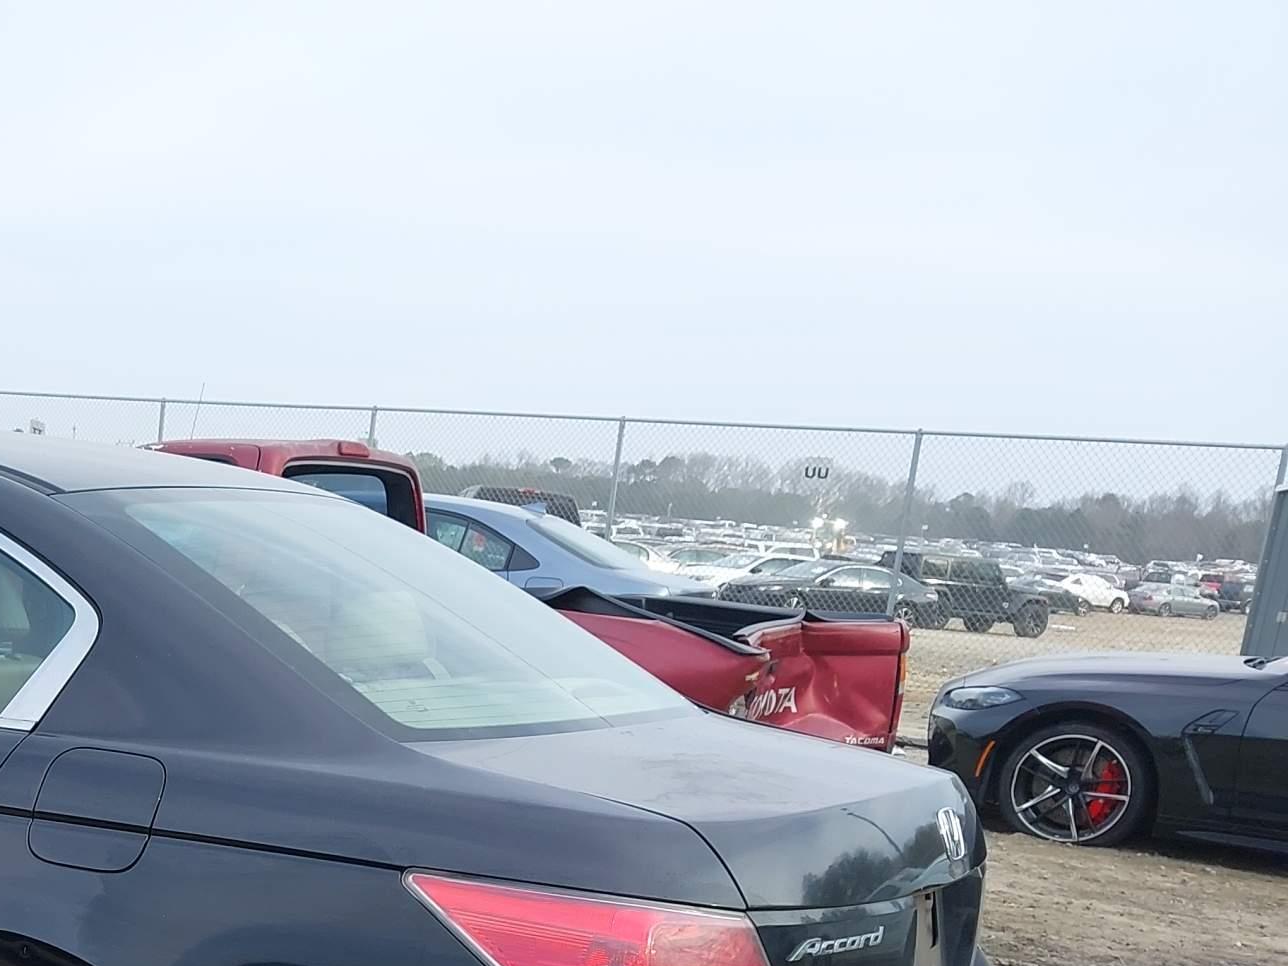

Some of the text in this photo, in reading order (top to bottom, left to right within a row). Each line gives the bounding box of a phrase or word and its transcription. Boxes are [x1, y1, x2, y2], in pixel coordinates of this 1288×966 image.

[804, 465, 830, 479] UU
[844, 734, 885, 746] TACOMA
[785, 926, 885, 962] Accord
